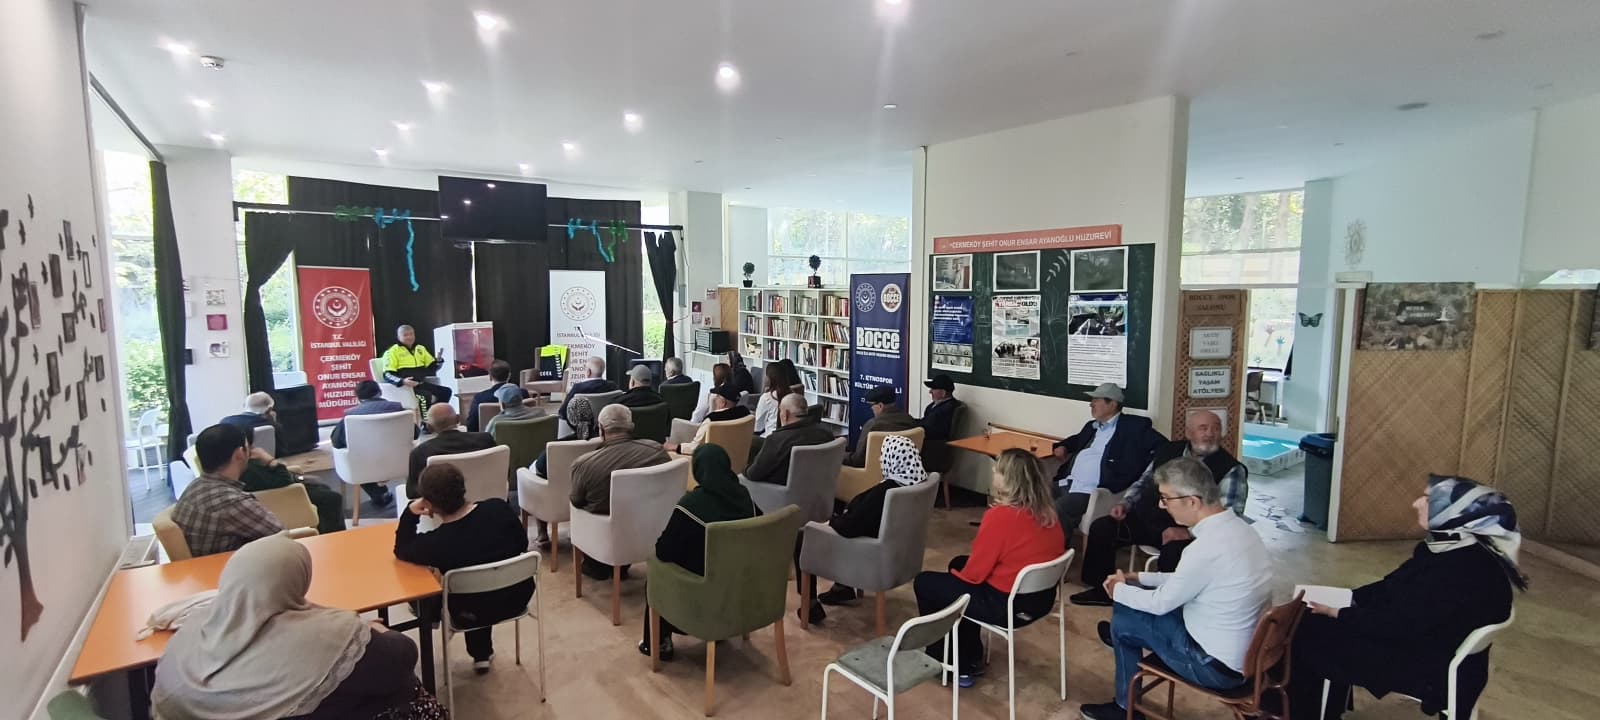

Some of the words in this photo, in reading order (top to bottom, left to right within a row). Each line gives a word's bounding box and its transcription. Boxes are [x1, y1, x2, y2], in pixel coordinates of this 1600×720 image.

[998, 239, 1016, 248] ONUR
[310, 341, 341, 349] İSTANBUL
[319, 353, 361, 363] ÇEKMEKÖY
[317, 373, 340, 381] ONUR
[341, 371, 366, 379] ENSAR
[323, 390, 357, 399] HUZURE
